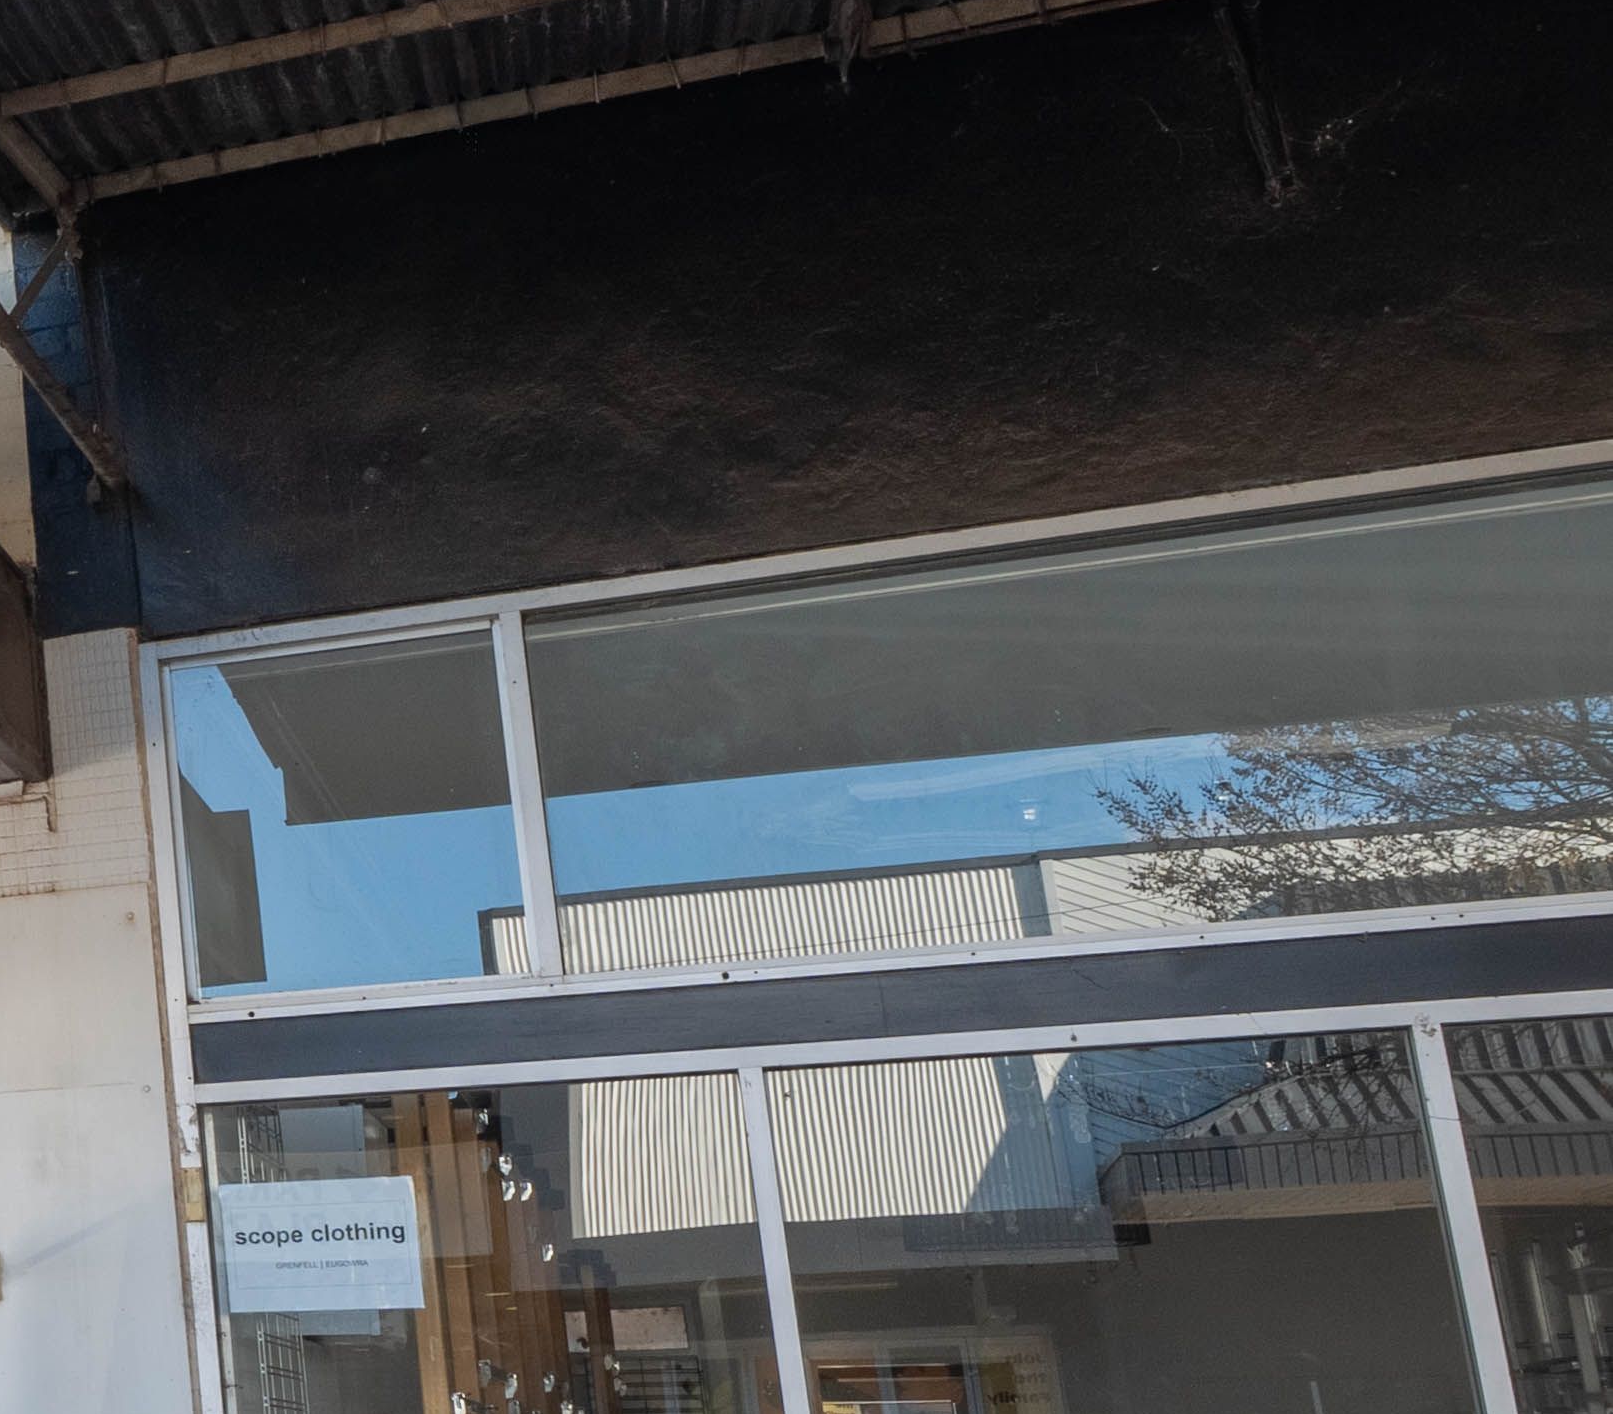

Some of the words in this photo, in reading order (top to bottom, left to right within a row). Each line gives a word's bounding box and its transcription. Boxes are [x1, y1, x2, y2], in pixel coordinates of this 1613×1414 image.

[235, 1229, 303, 1248] scope
[311, 1222, 405, 1244] clothing
[276, 1260, 319, 1269] GRENFELL
